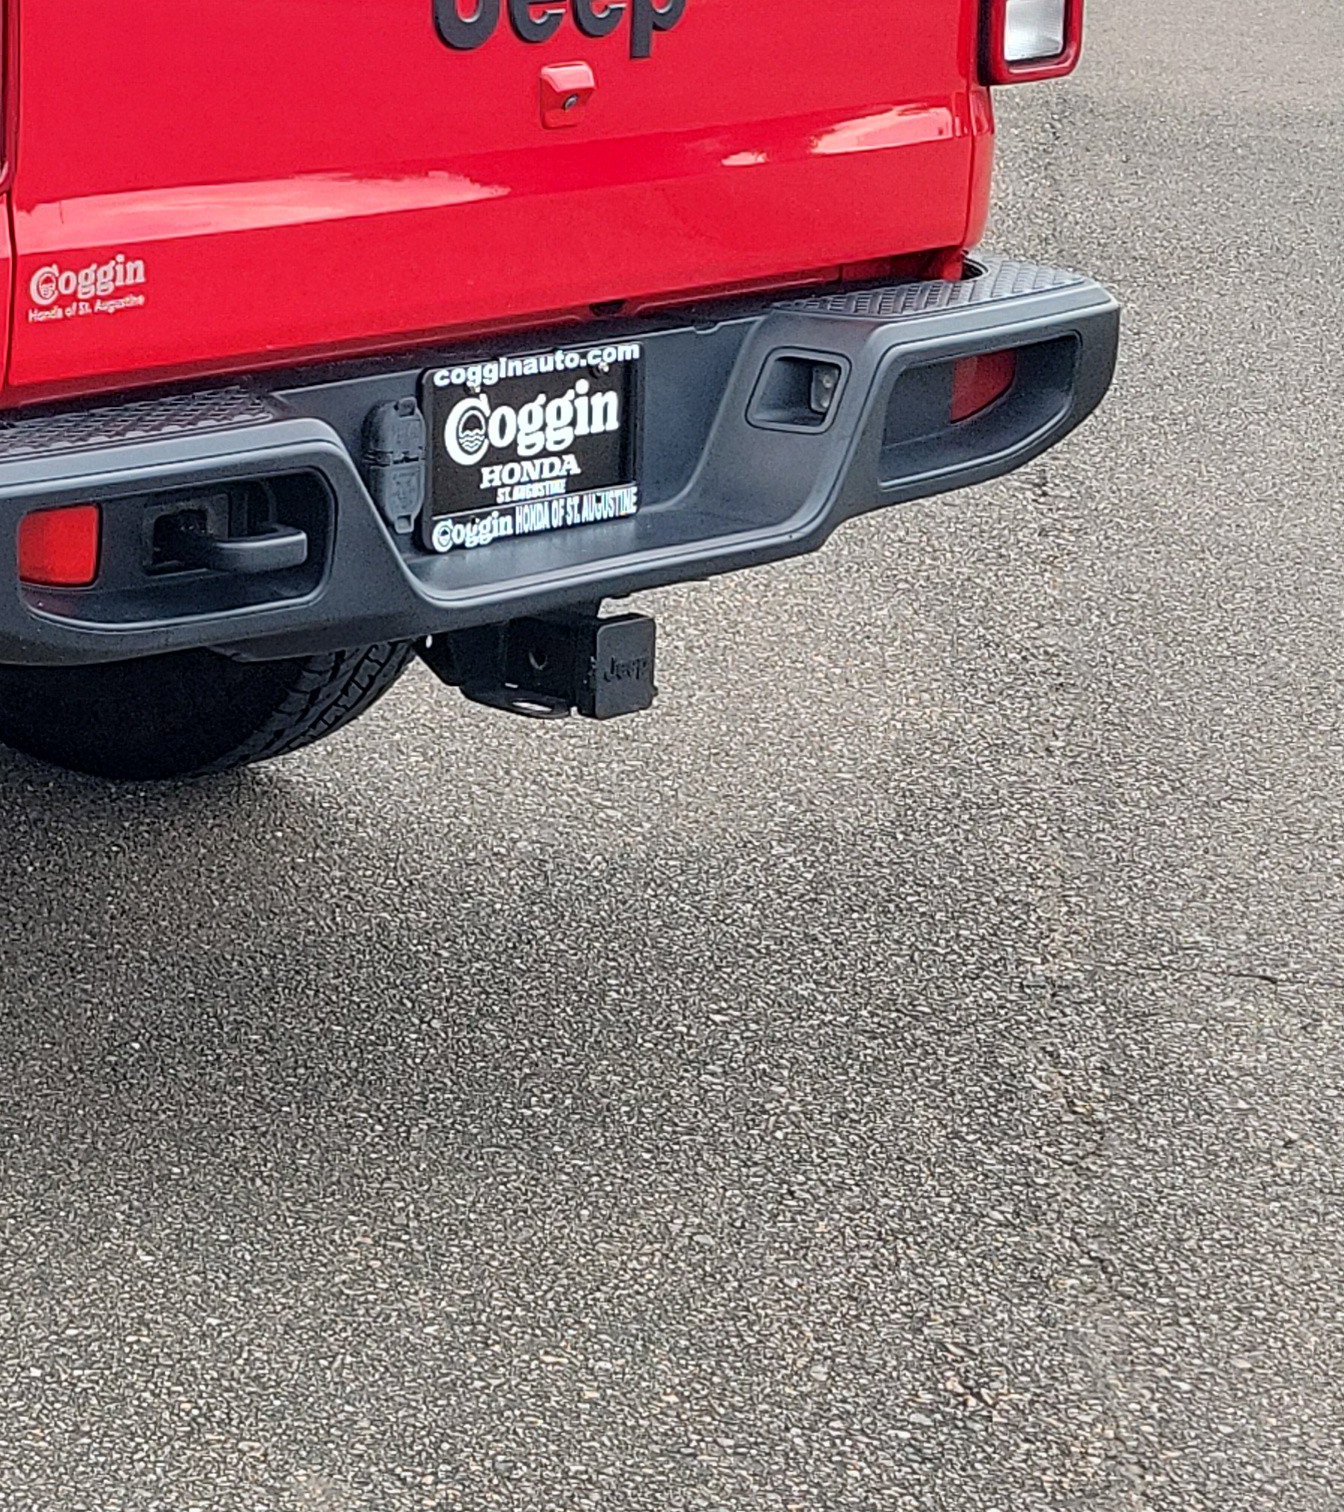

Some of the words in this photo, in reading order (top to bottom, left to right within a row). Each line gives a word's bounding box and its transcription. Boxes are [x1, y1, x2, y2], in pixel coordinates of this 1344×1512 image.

[29, 253, 146, 306] Coggin
[432, 343, 641, 388] cogginauto.com
[444, 378, 620, 466] Coggin
[479, 454, 582, 489] HONDA
[432, 510, 514, 553] Coggin
[515, 501, 552, 535] HONDA
[552, 498, 565, 529] OF
[581, 485, 639, 522] AUGUSTINE
[602, 656, 648, 683] Jeep
